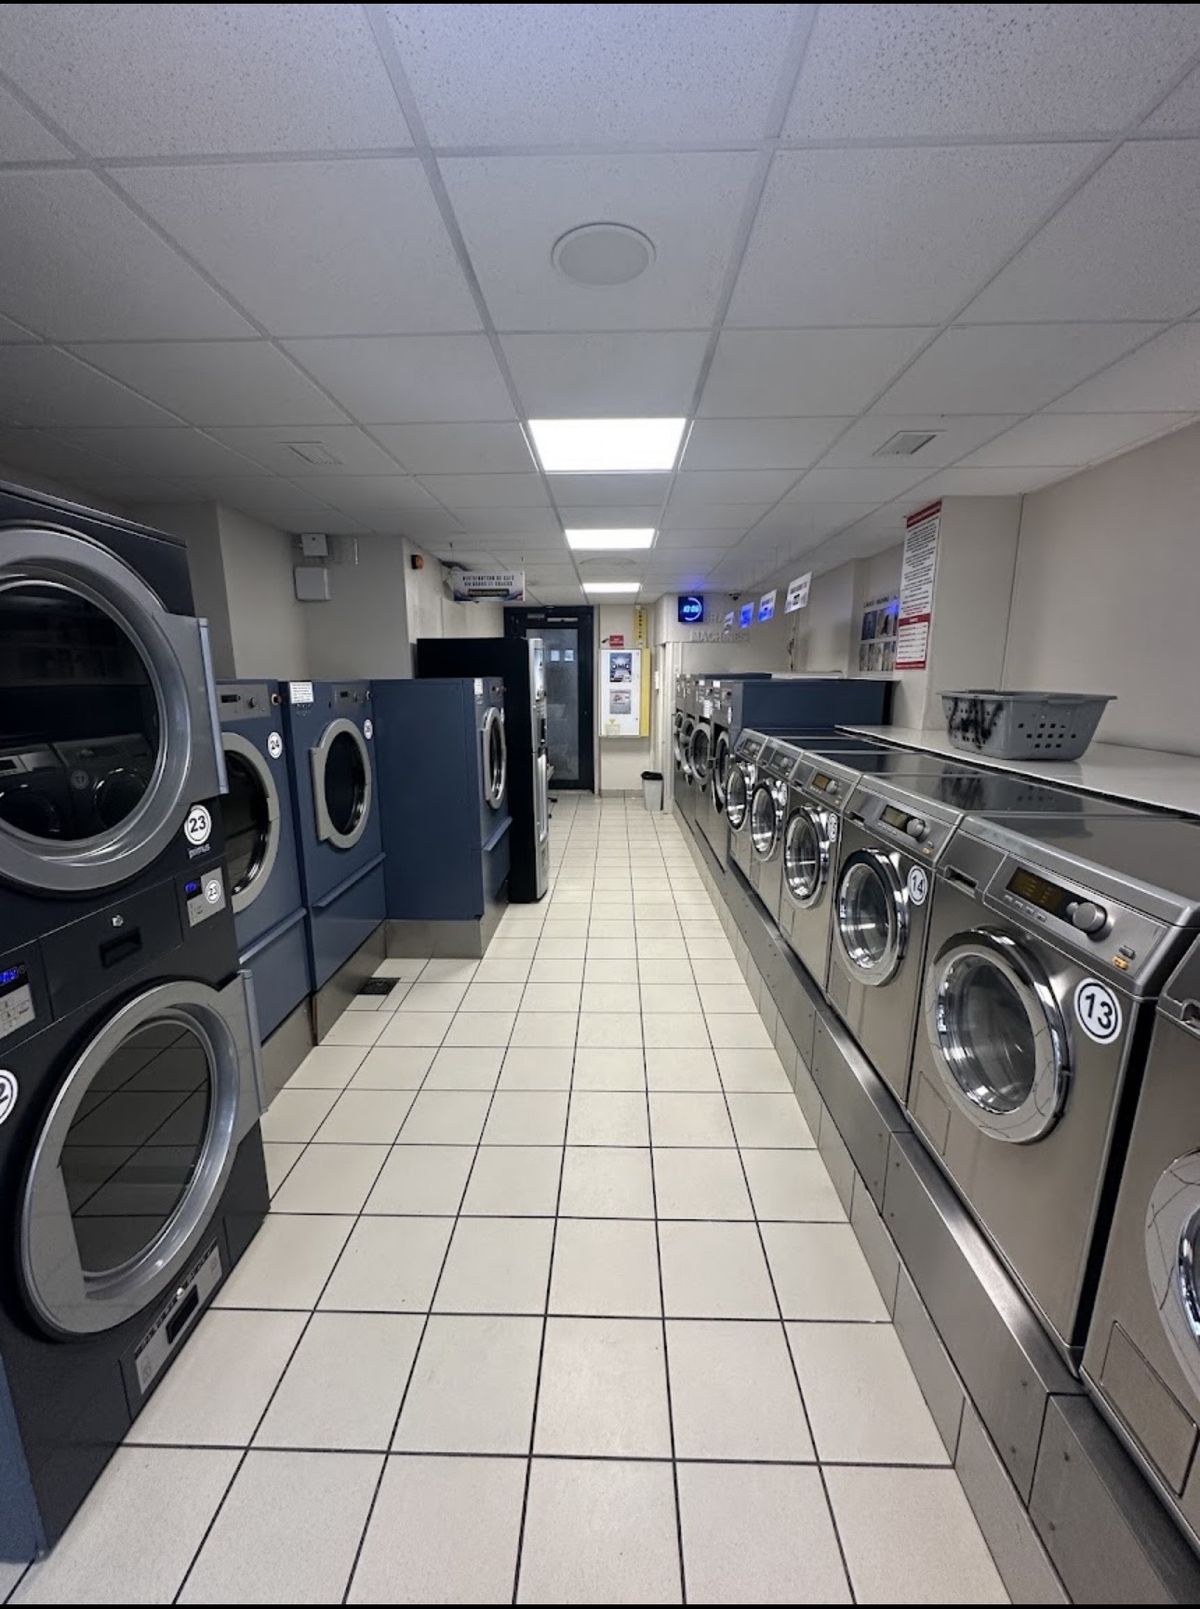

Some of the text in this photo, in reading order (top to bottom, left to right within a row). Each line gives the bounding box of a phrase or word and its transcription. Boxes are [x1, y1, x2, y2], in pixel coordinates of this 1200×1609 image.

[270, 739, 280, 750] 24
[189, 815, 207, 834] 23
[911, 875, 924, 895] 14
[1084, 992, 1113, 1030] 13
